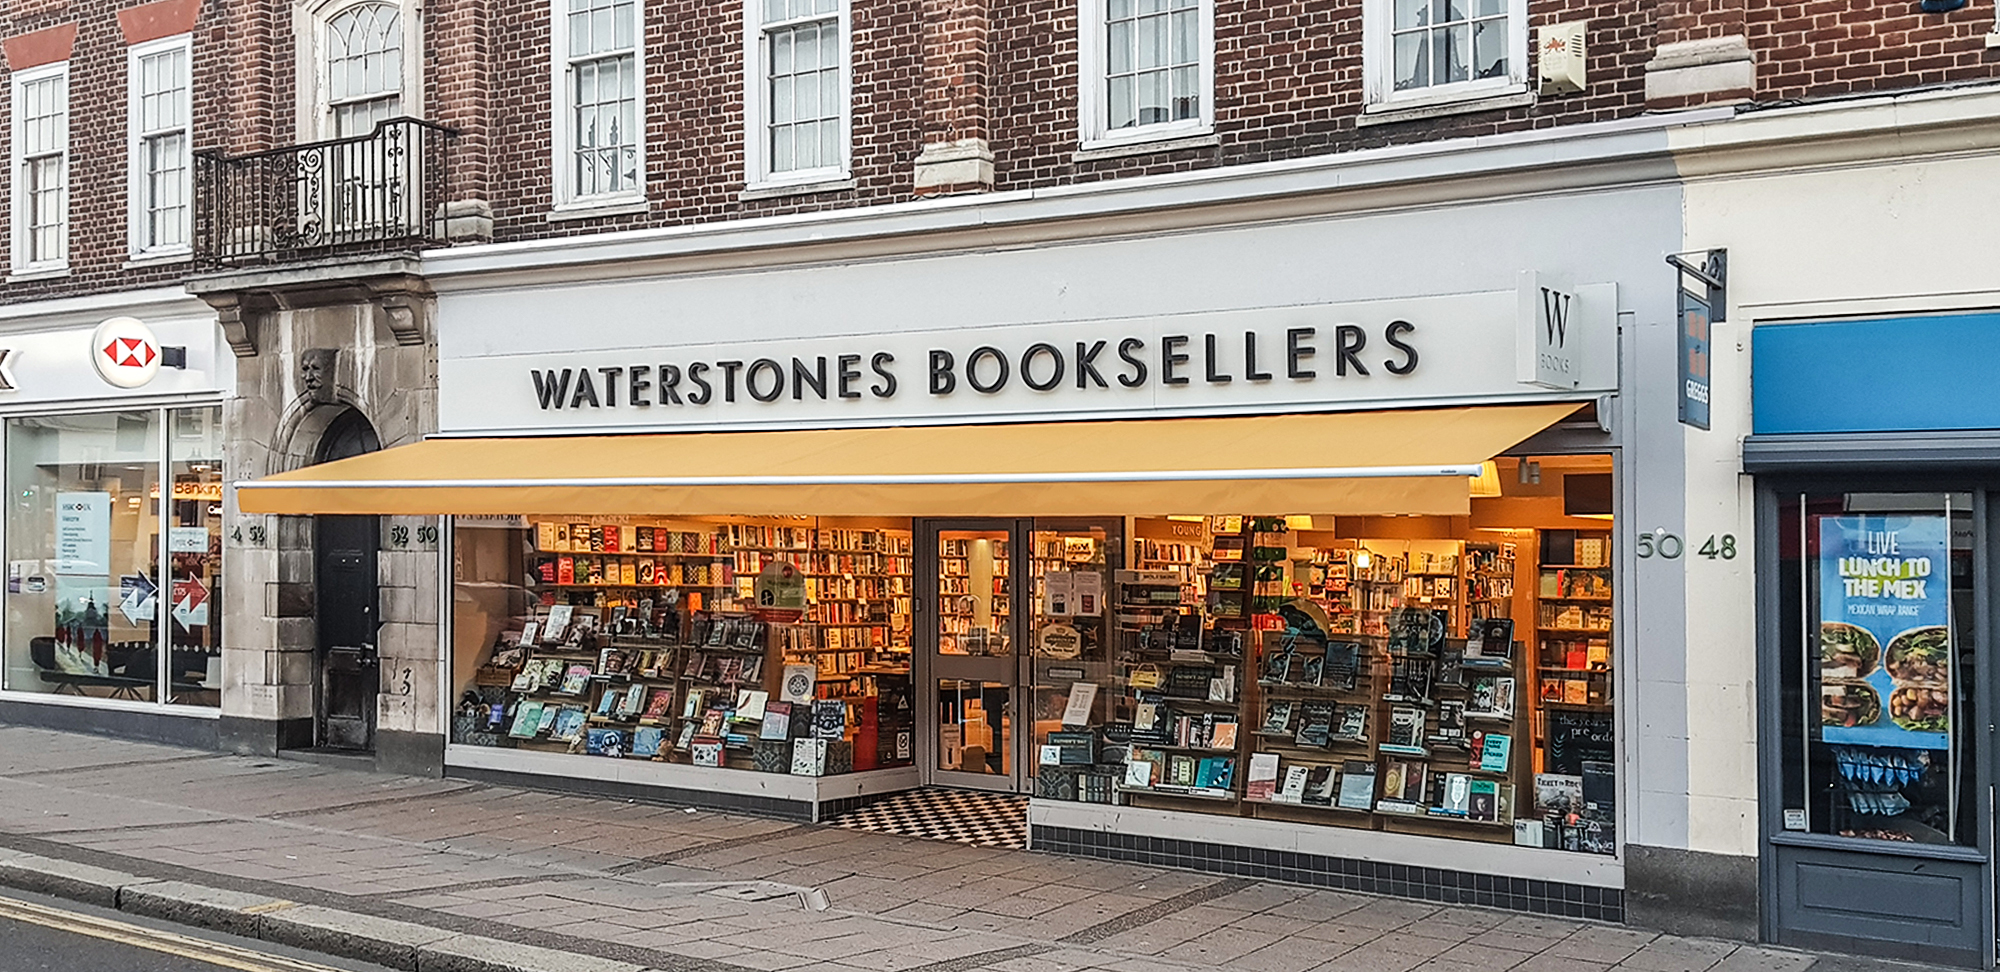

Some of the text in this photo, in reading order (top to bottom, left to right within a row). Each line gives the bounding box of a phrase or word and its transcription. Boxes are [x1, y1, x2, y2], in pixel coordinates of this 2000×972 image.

[1541, 287, 1570, 348] W
[531, 320, 1419, 410] WATERSTONES BOOKSELLERS
[1541, 353, 1569, 373] BOOKS
[1686, 379, 1708, 404] GREGGS
[249, 525, 265, 545] 52
[391, 525, 439, 545] 52 50
[1172, 525, 1201, 536] YOUNG
[1637, 532, 1737, 560] 50 48
[1868, 531, 1900, 555] LIVE
[1838, 556, 1931, 577] LUNCH TO
[1843, 578, 1927, 600] THE MEX
[1847, 604, 1920, 616] MEXICAN WRAP RANGE
